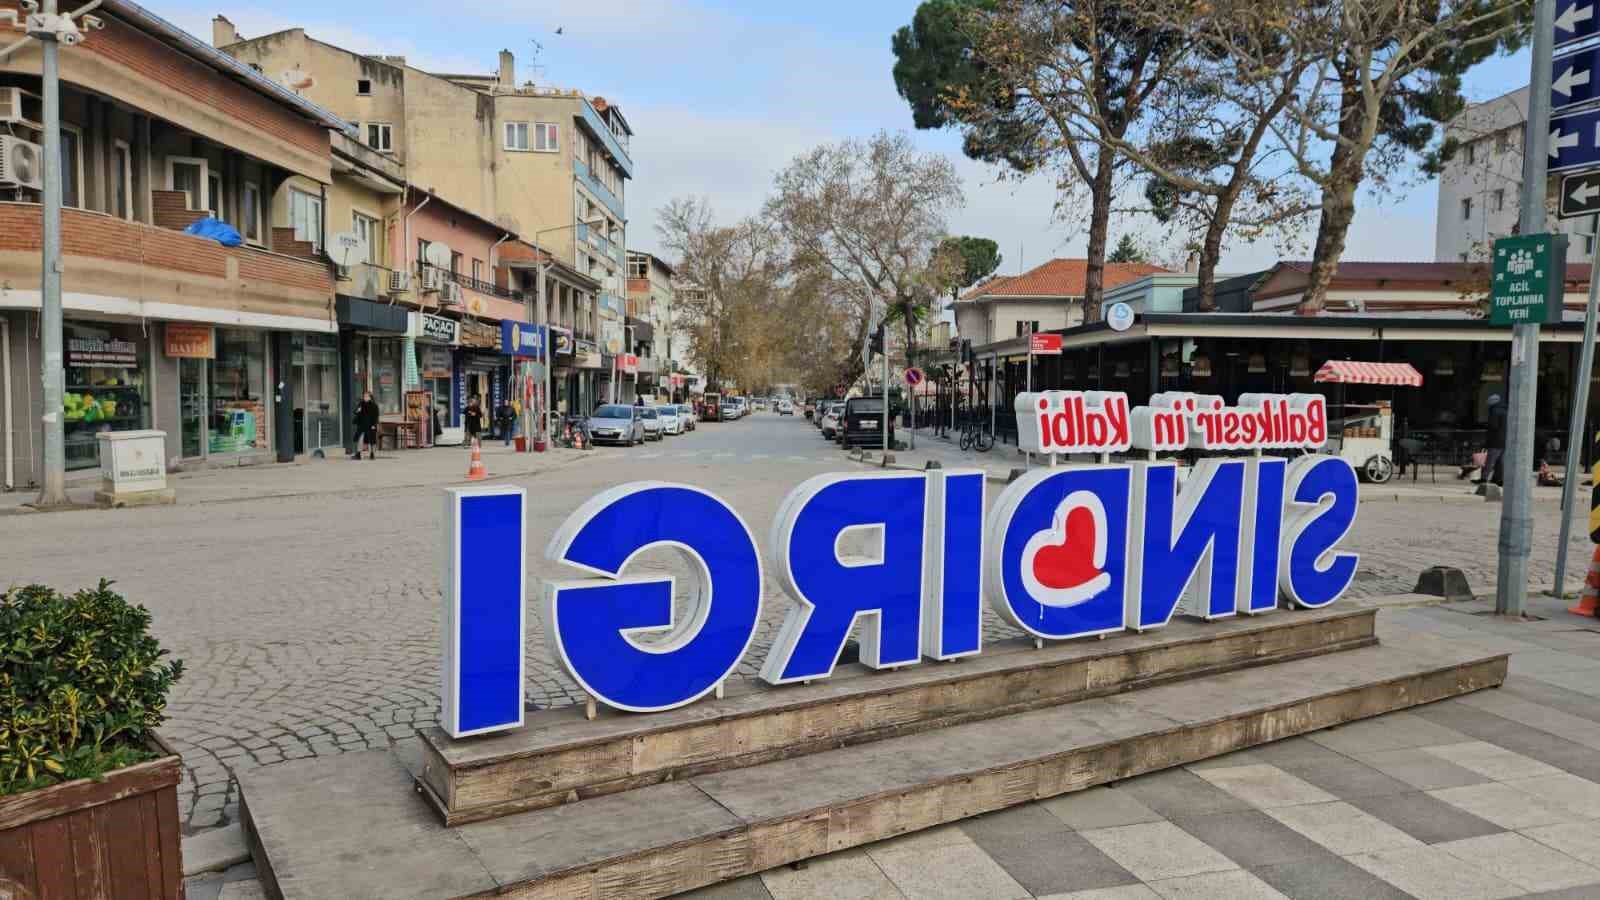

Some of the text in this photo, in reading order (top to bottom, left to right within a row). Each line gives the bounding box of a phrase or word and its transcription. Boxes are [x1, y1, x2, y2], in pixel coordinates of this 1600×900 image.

[1509, 280, 1530, 292] ACİL
[1495, 294, 1544, 306] TOPLANMA
[1508, 307, 1529, 319] YERİ
